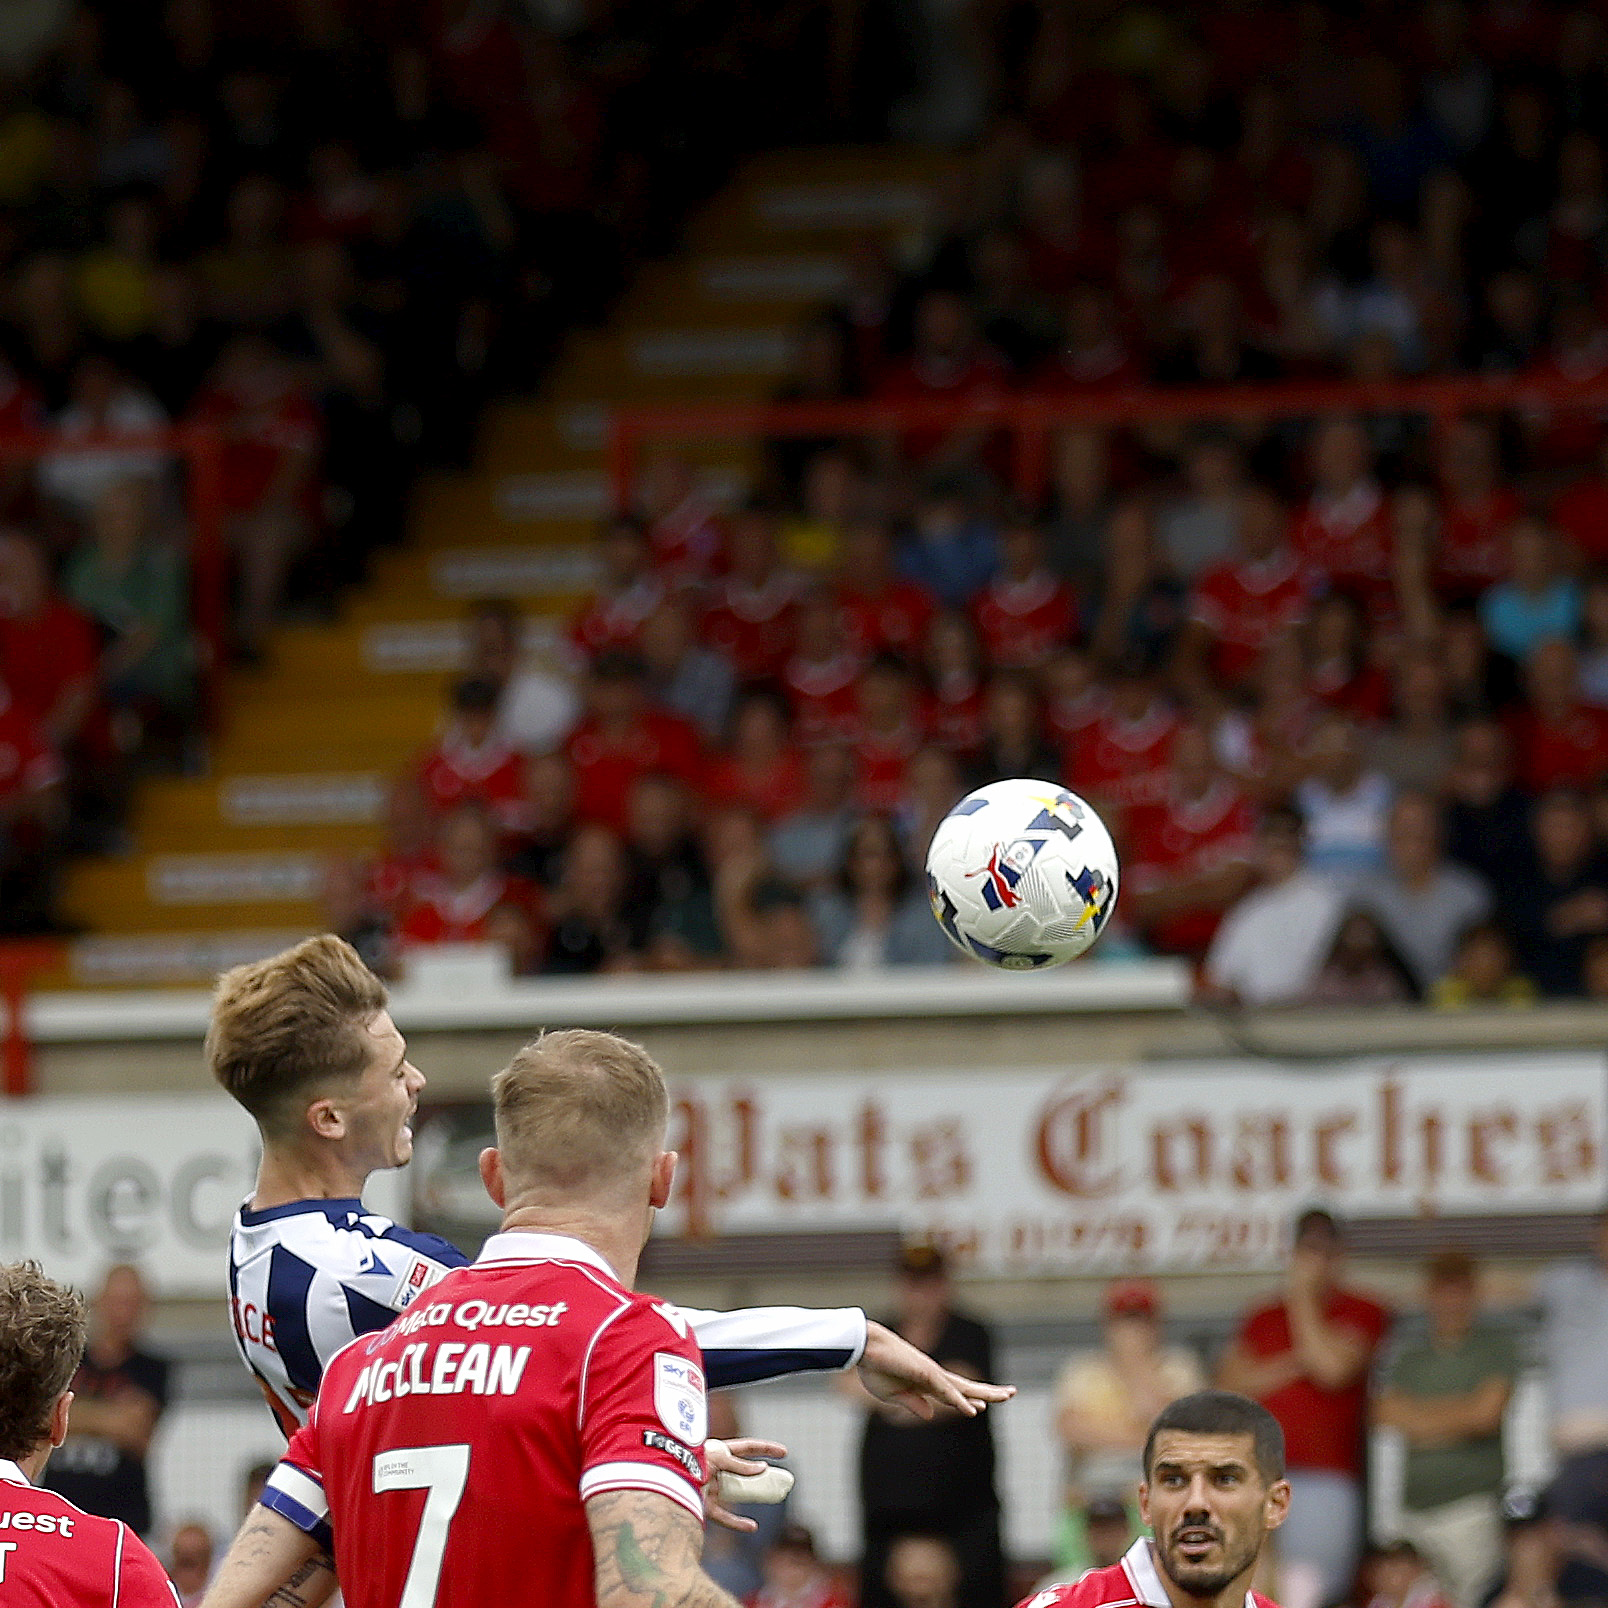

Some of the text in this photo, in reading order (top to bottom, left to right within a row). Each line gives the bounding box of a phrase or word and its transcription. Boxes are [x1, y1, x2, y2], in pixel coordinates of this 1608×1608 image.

[1032, 1066, 1600, 1218] Coaches
[395, 1299, 569, 1337] Meta Quest
